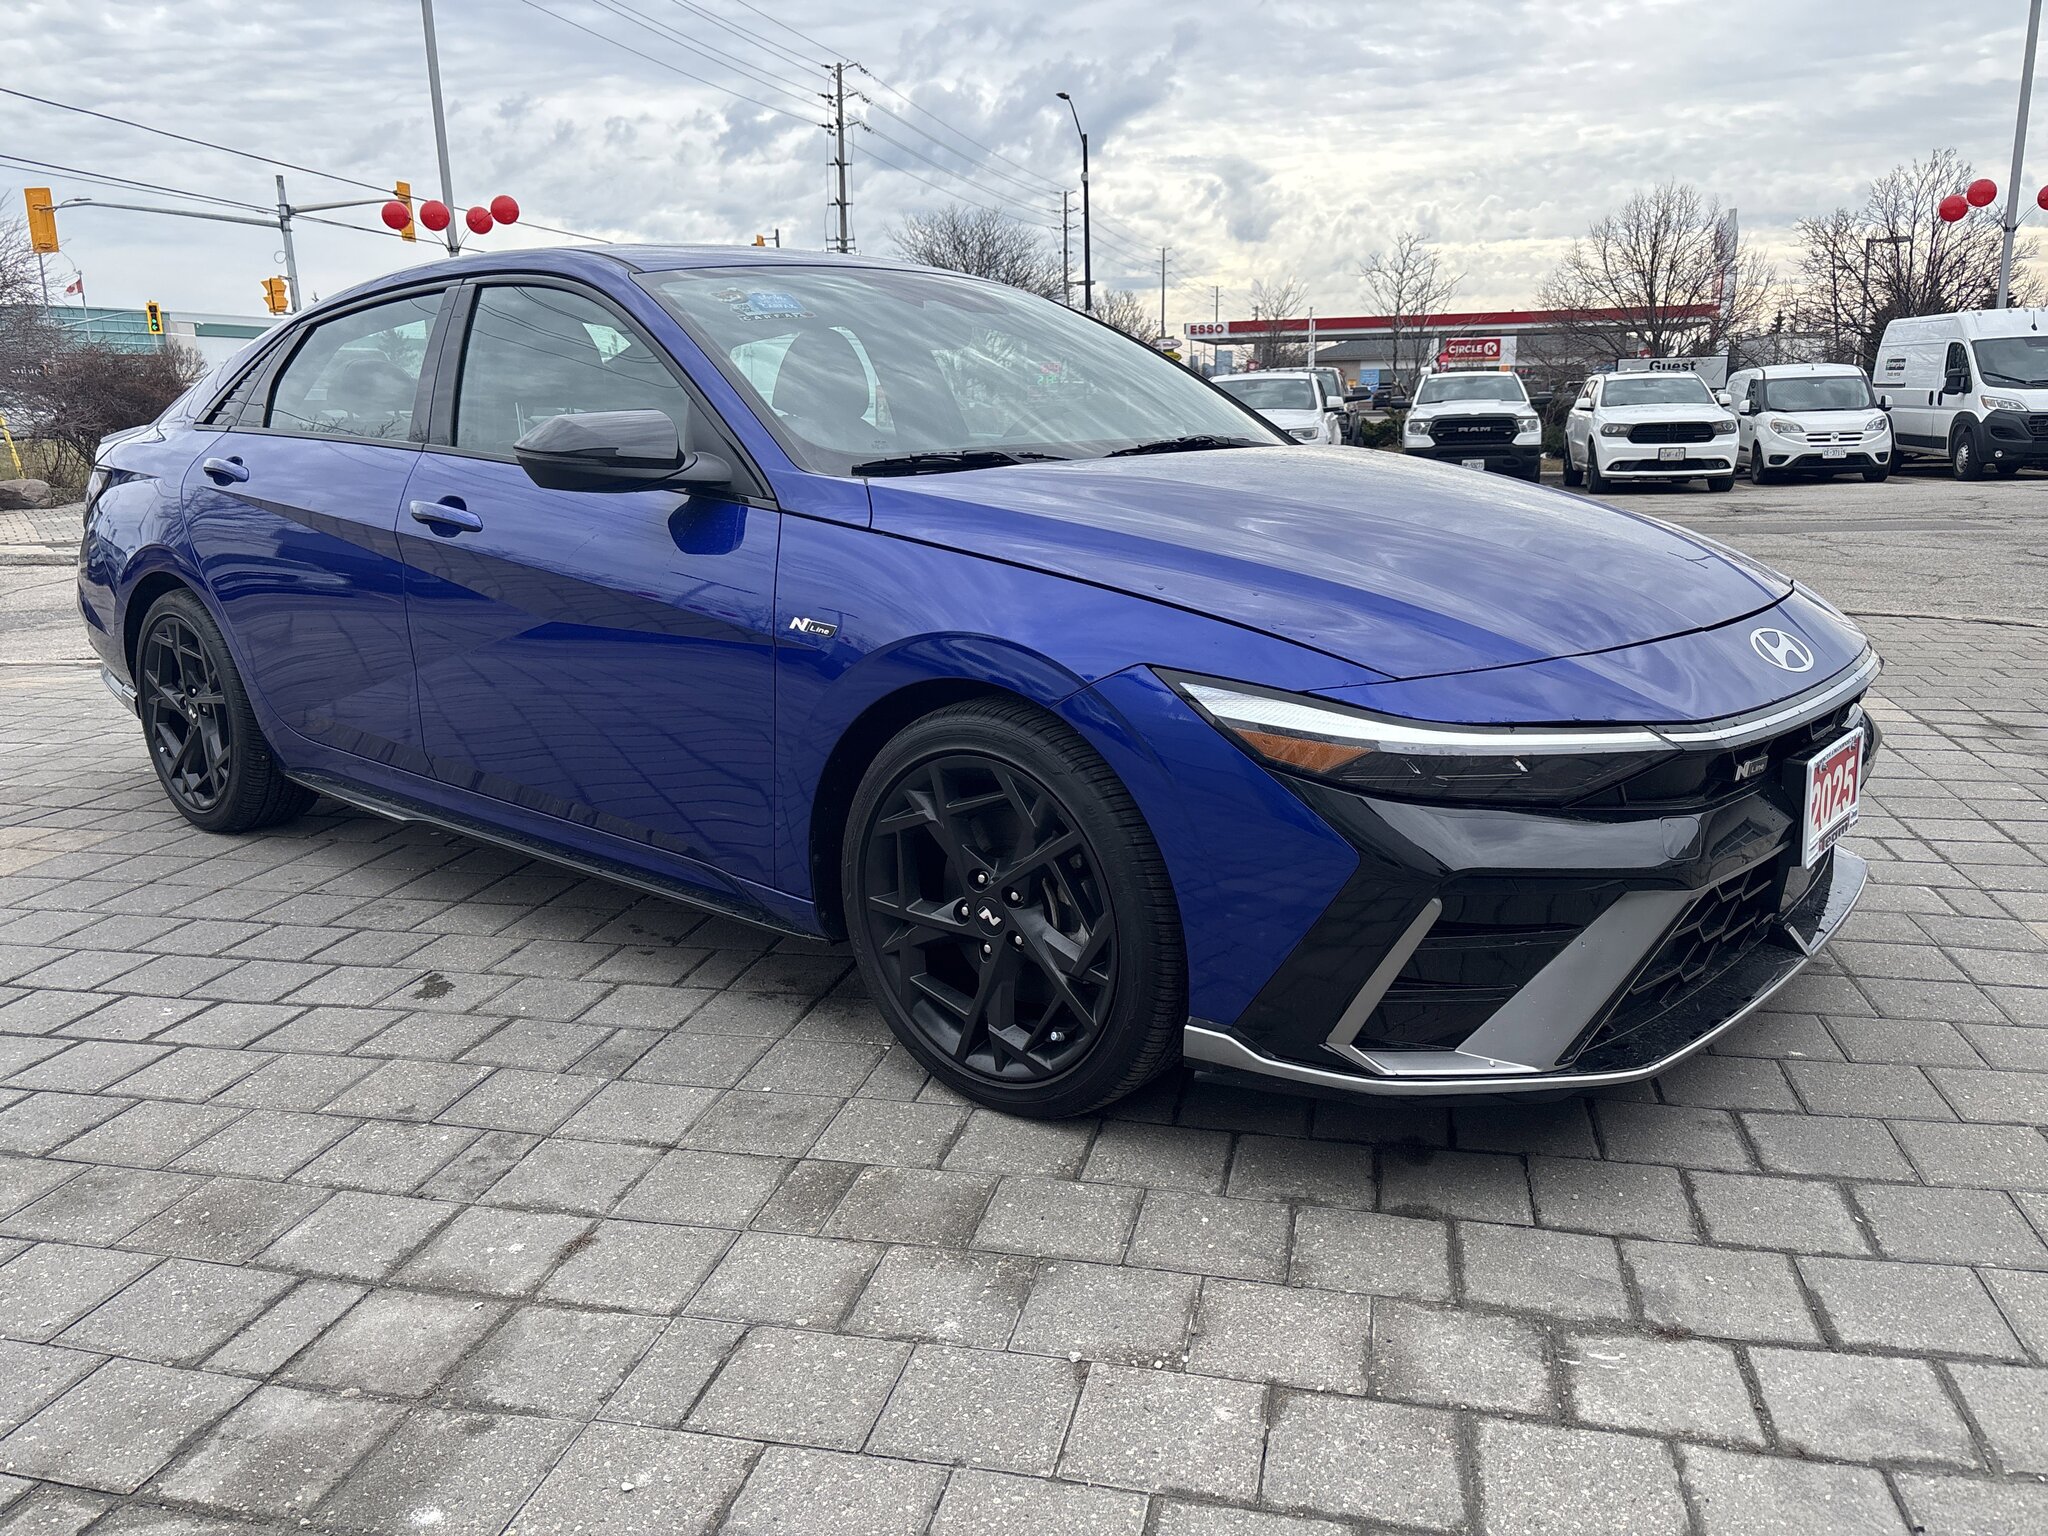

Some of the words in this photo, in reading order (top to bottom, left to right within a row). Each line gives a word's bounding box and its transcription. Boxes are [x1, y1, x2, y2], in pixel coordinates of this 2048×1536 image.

[1190, 324, 1224, 335] ESSO
[1448, 345, 1483, 354] CIRCLE
[1649, 360, 1697, 371] Guest
[789, 616, 811, 633] N
[809, 625, 830, 635] Line
[1811, 756, 1856, 832] 2025
[1818, 812, 1850, 852] Team
